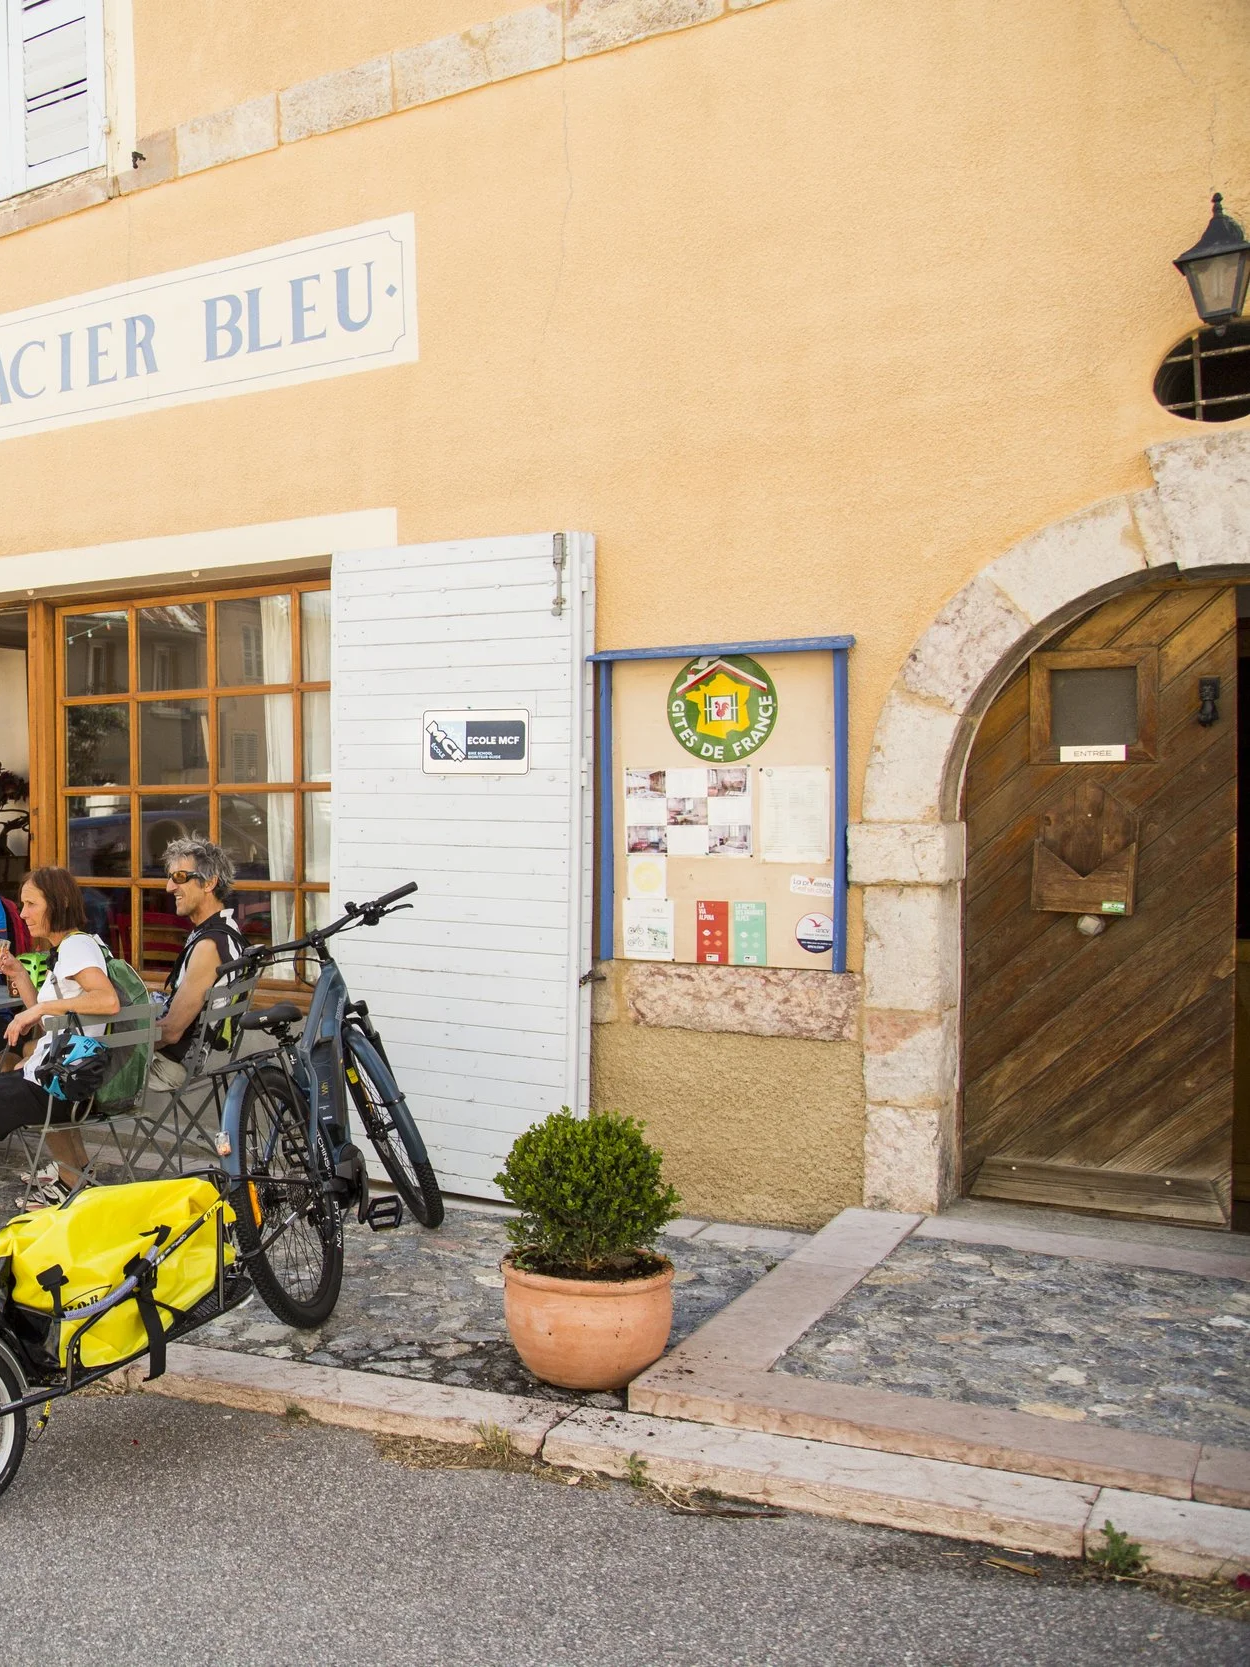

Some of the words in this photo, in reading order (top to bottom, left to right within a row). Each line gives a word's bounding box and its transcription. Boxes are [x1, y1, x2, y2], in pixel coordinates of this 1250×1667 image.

[202, 261, 376, 364] BLEU
[467, 736, 497, 745] ECOLE
[498, 736, 520, 745] MCF
[700, 742, 724, 759] DE
[732, 696, 773, 756] FRANCE
[332, 1201, 343, 1249] PYTON
